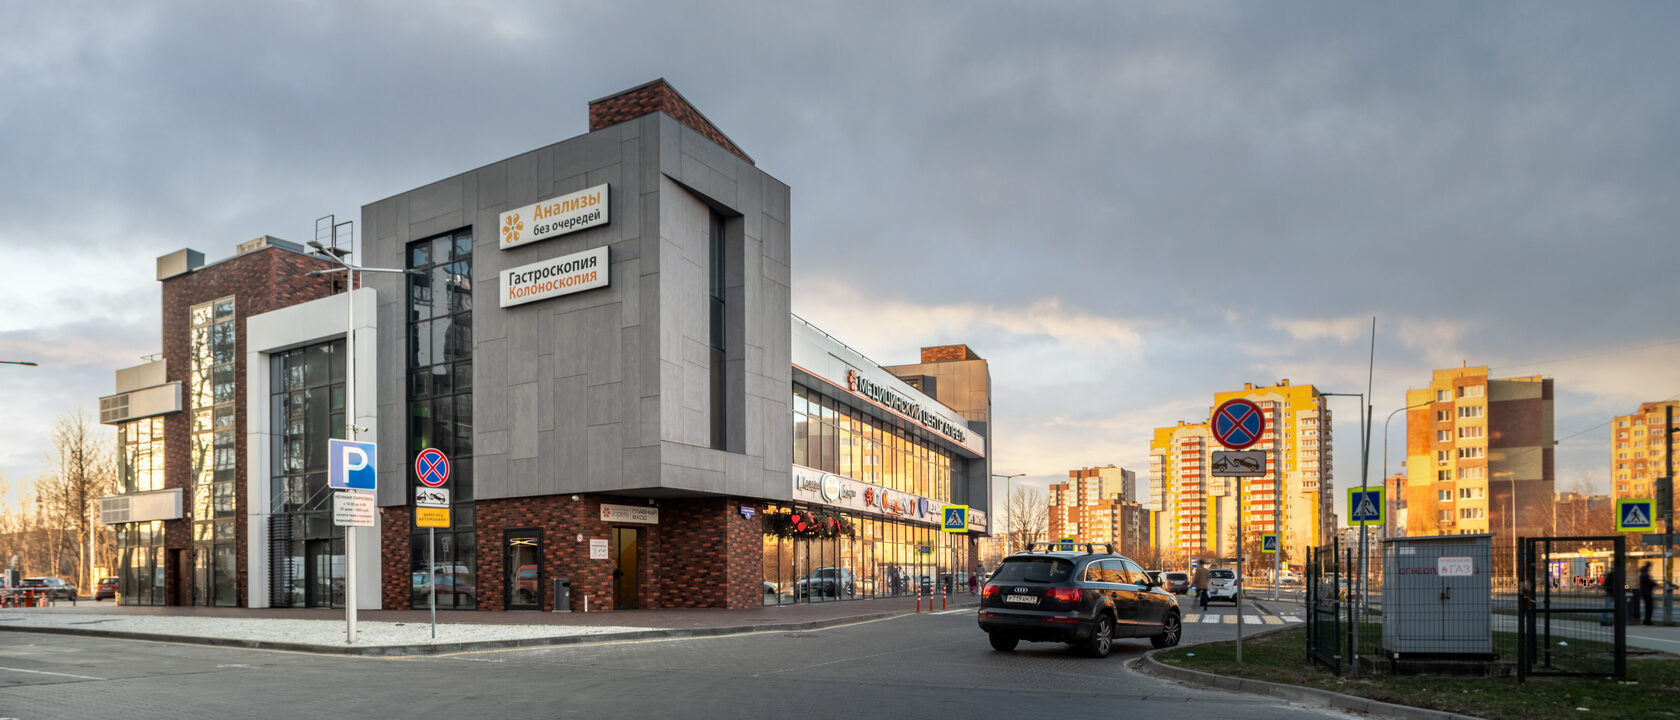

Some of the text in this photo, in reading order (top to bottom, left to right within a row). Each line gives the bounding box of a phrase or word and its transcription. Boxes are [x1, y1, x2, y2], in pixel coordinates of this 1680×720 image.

[533, 192, 600, 221] Анализы
[533, 208, 601, 236] без очередей
[509, 256, 597, 286] Гастроскопия
[509, 271, 597, 300] Колоноскопия
[857, 376, 920, 420] МЕДИЦИНСКИЙ
[921, 410, 942, 430] ЦЕНТР
[342, 446, 369, 484] P
[1398, 567, 1437, 575] ОГНЕОП
[1450, 564, 1471, 574] ГАЗ
